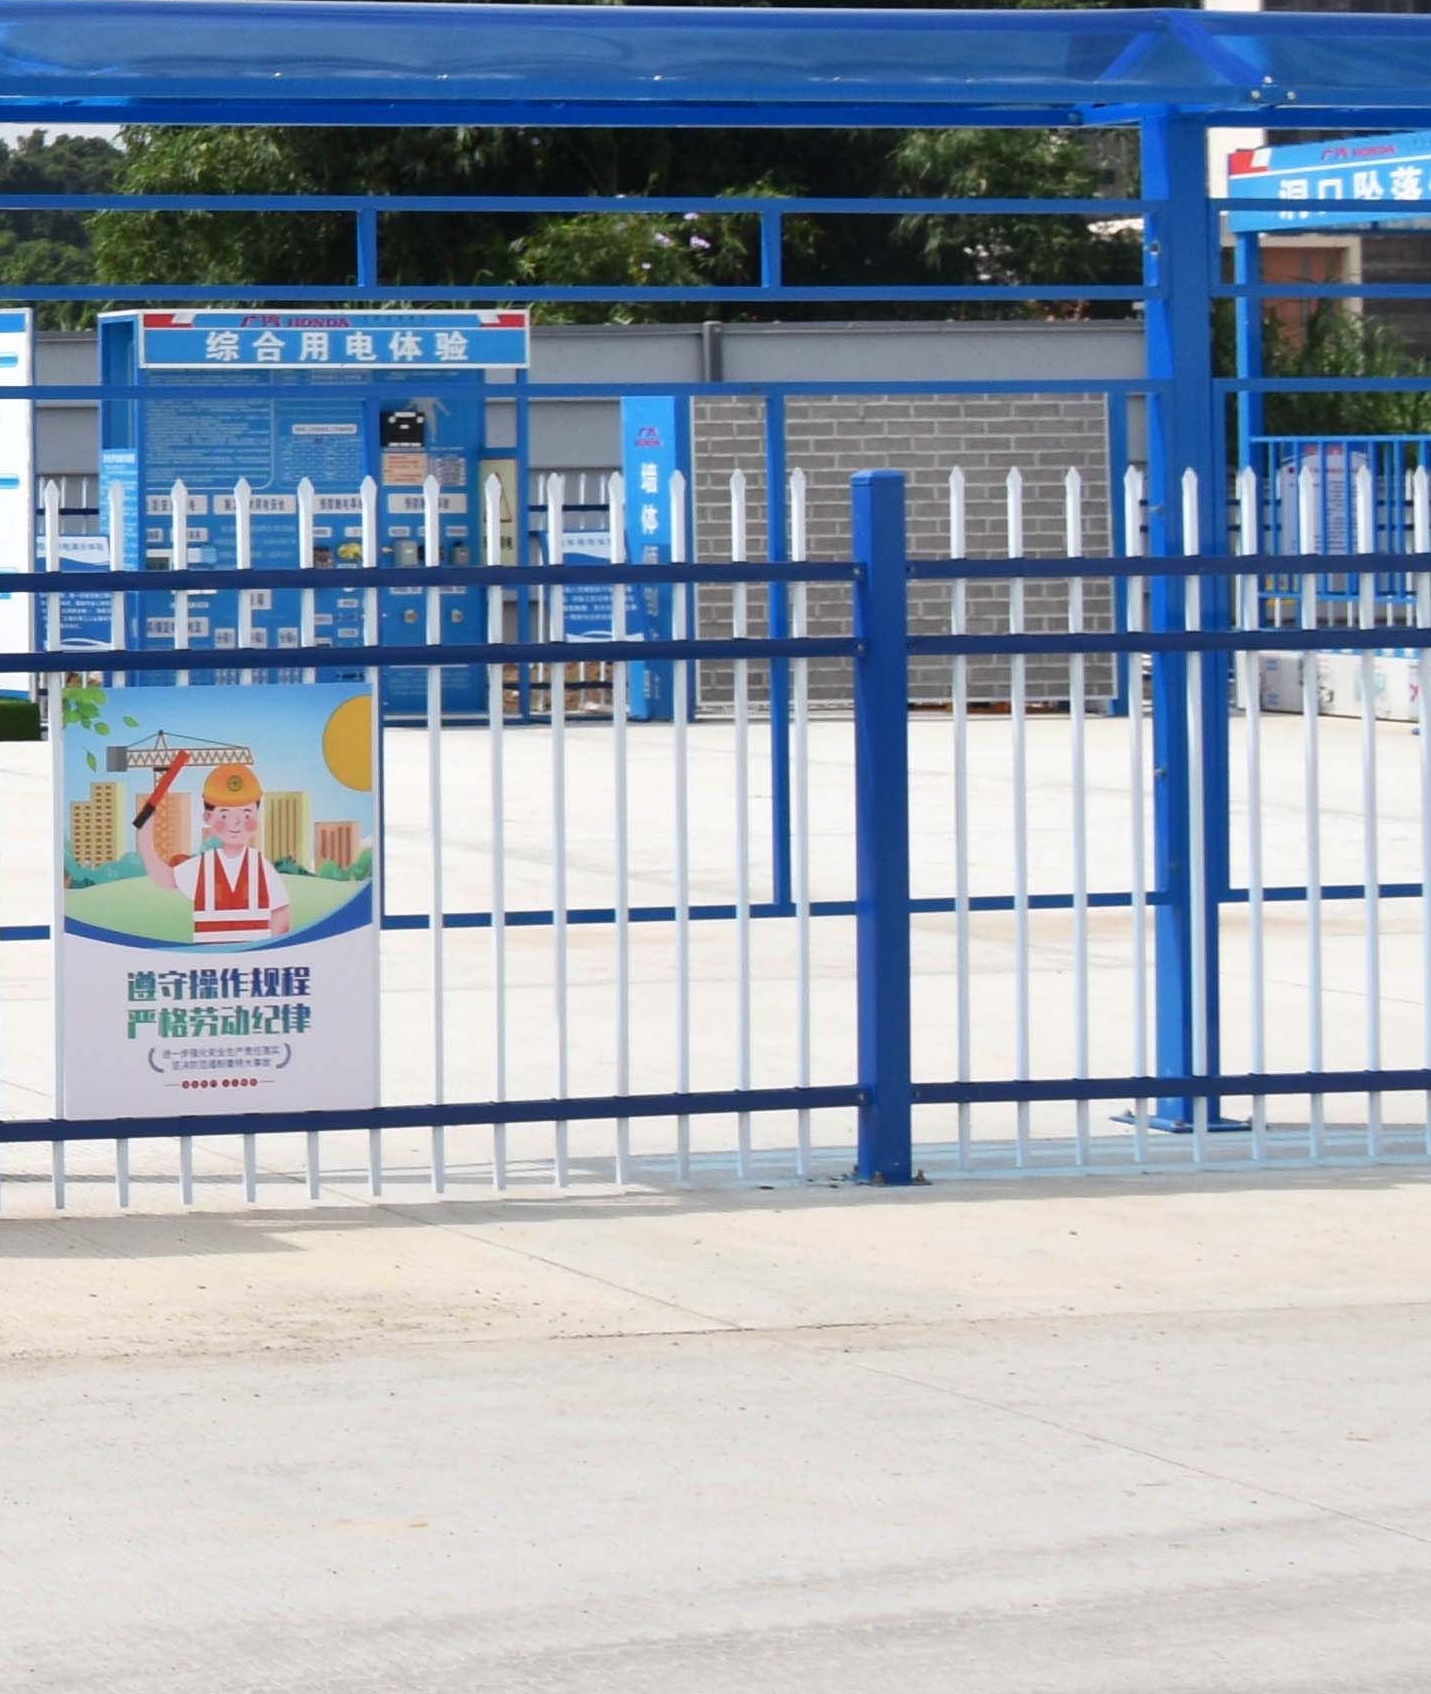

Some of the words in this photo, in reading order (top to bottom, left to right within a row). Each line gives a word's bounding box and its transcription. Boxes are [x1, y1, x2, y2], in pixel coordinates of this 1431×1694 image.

[1279, 165, 1431, 220] 洞口坠落
[206, 332, 469, 362] 综合用电体验
[127, 966, 311, 1001] 遵守操作规程
[127, 1003, 311, 1039] 严格劳动纪律
